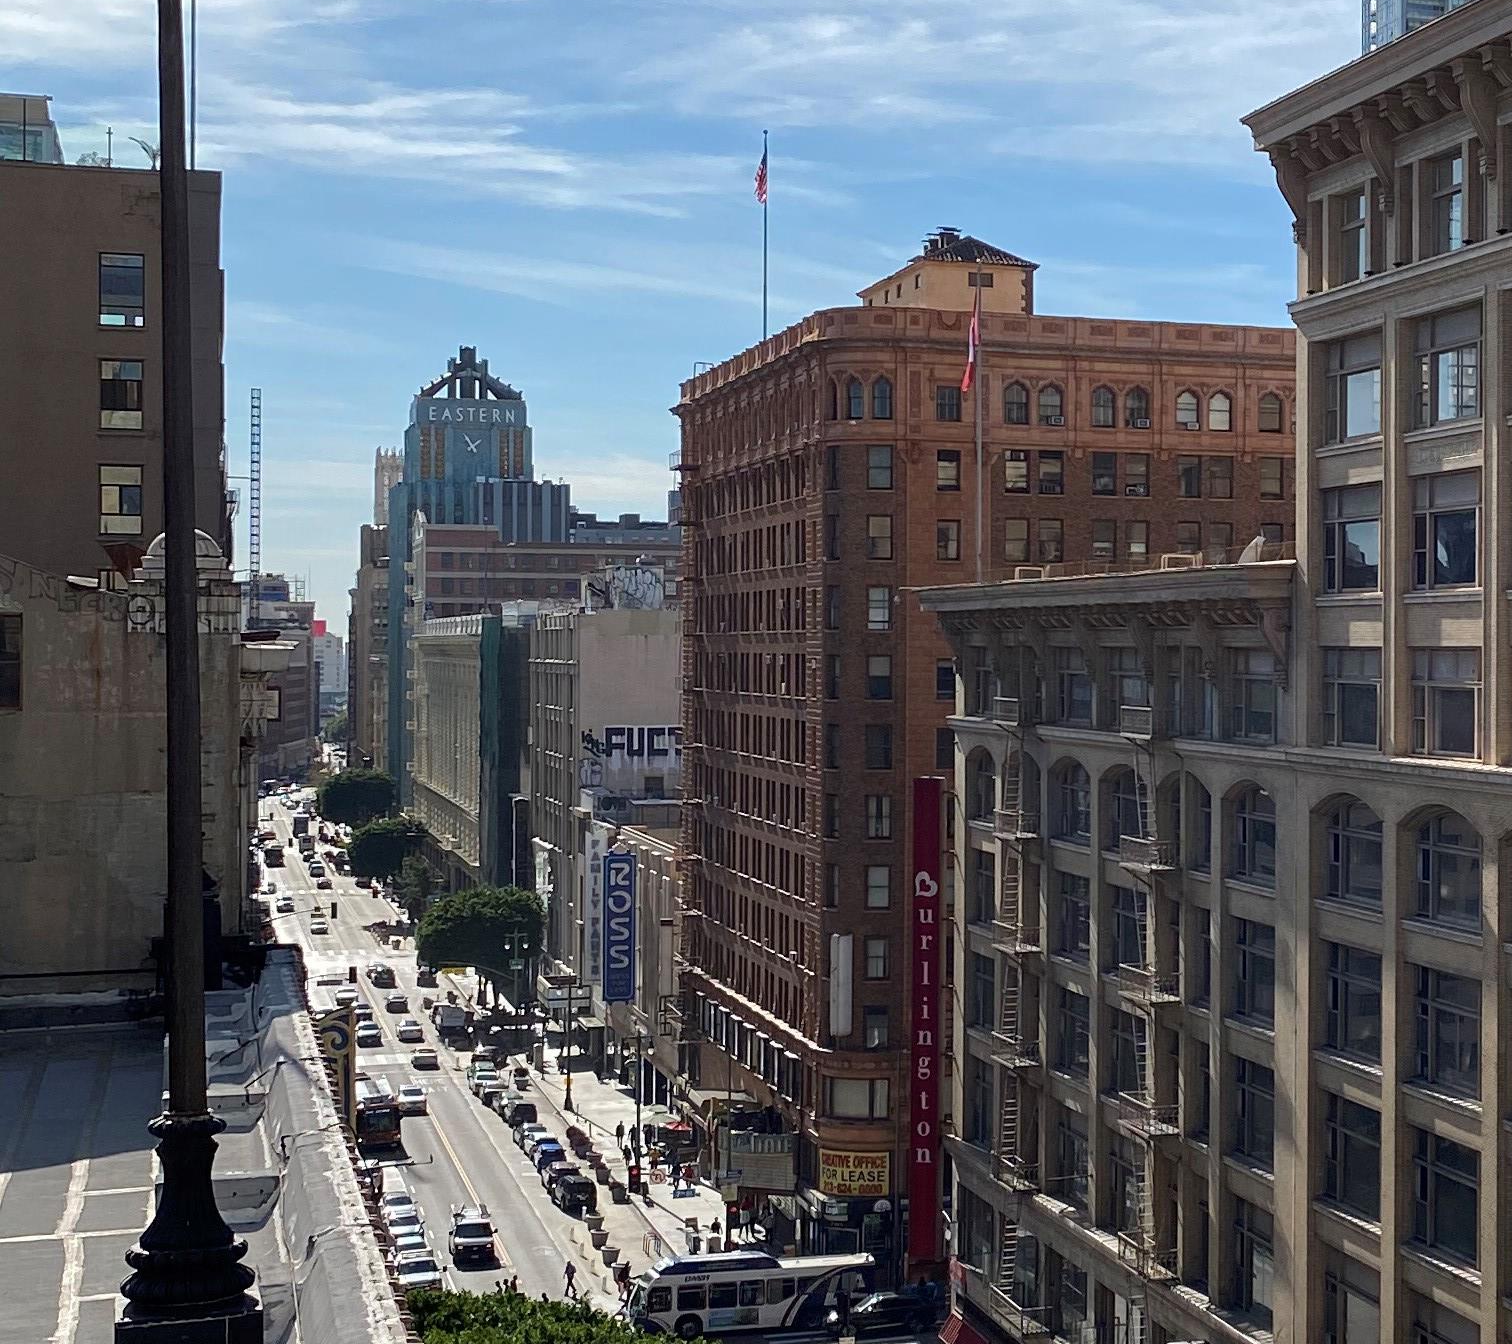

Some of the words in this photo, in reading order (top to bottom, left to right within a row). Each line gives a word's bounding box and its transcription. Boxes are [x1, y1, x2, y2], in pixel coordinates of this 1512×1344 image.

[429, 406, 515, 423] EASTERN
[608, 863, 632, 969] ROSS
[914, 870, 938, 1164] Burlington
[852, 1156, 887, 1168] OFFICE
[822, 1167, 837, 1181] FOR
[841, 1169, 886, 1182] LEASE
